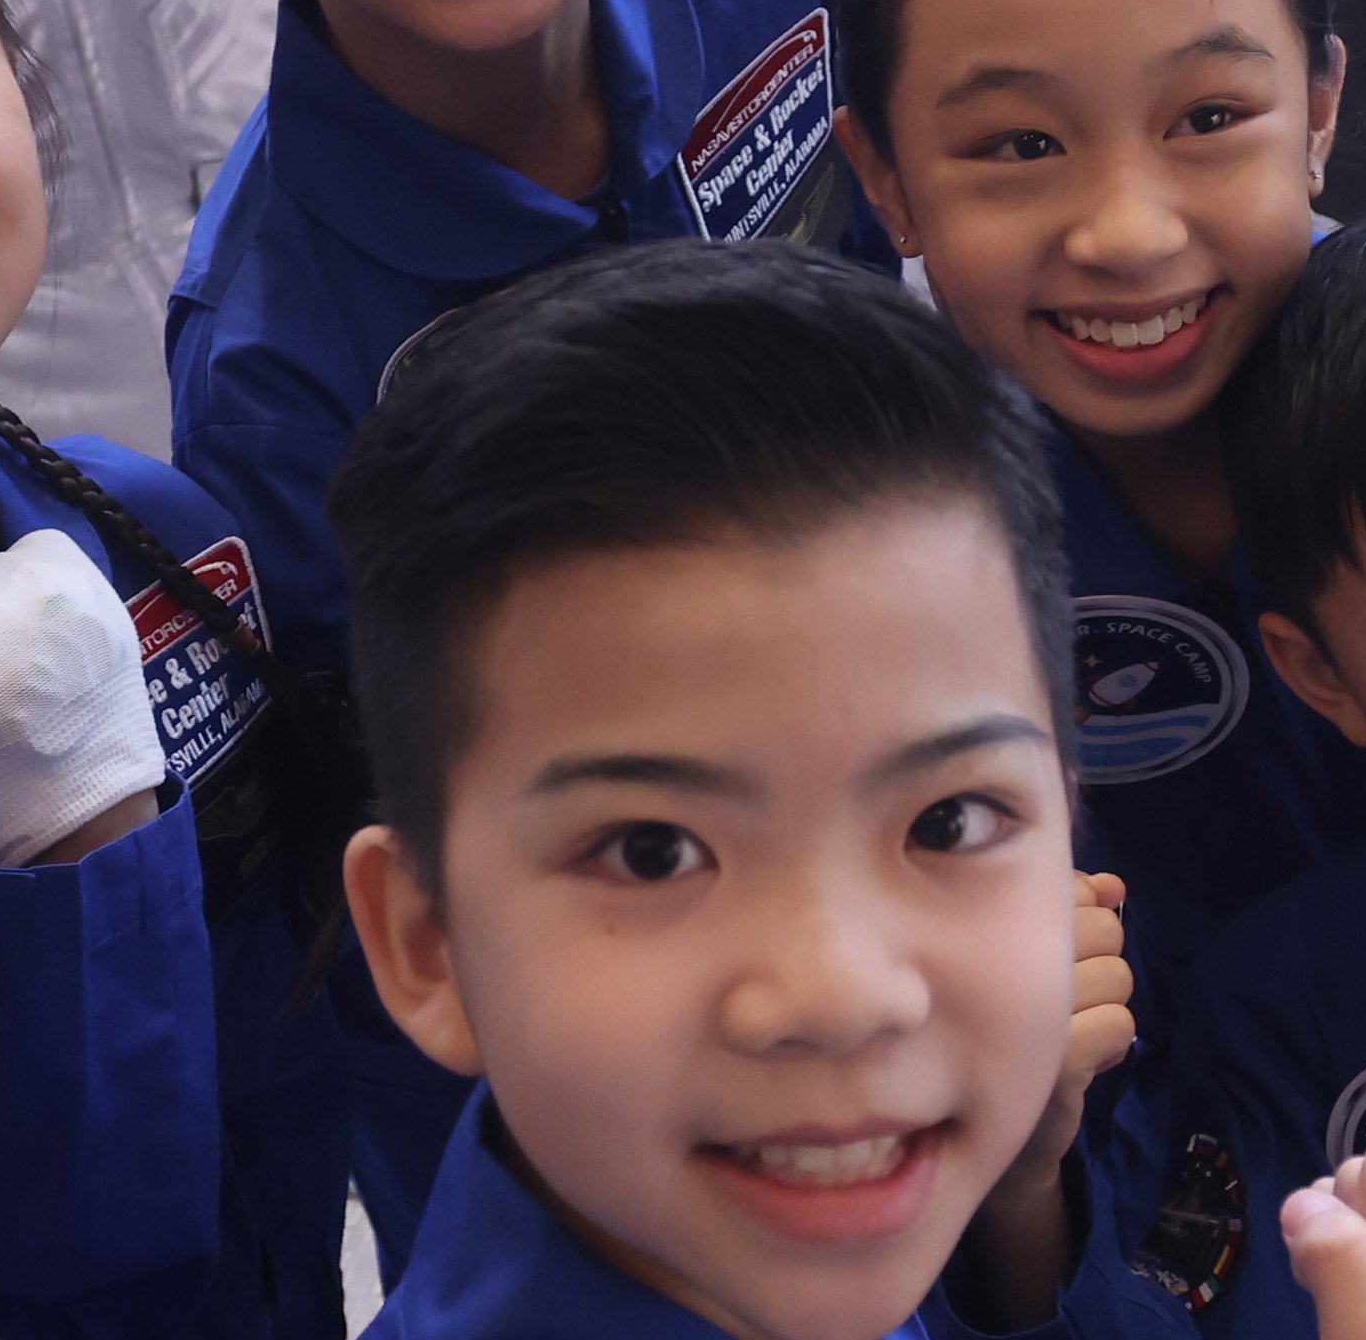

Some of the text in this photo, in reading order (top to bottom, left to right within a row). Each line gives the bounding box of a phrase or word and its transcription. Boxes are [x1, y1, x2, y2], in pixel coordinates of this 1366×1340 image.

[697, 59, 824, 212] Space & Rocket
[745, 128, 794, 197] Center
[724, 116, 828, 242] UNTSVILLE, ALABAMA
[165, 658, 193, 690] &
[1106, 622, 1175, 644] SPACE
[1175, 642, 1212, 684] CAMP
[161, 672, 230, 740] Center
[166, 725, 223, 772] SVILLE,
